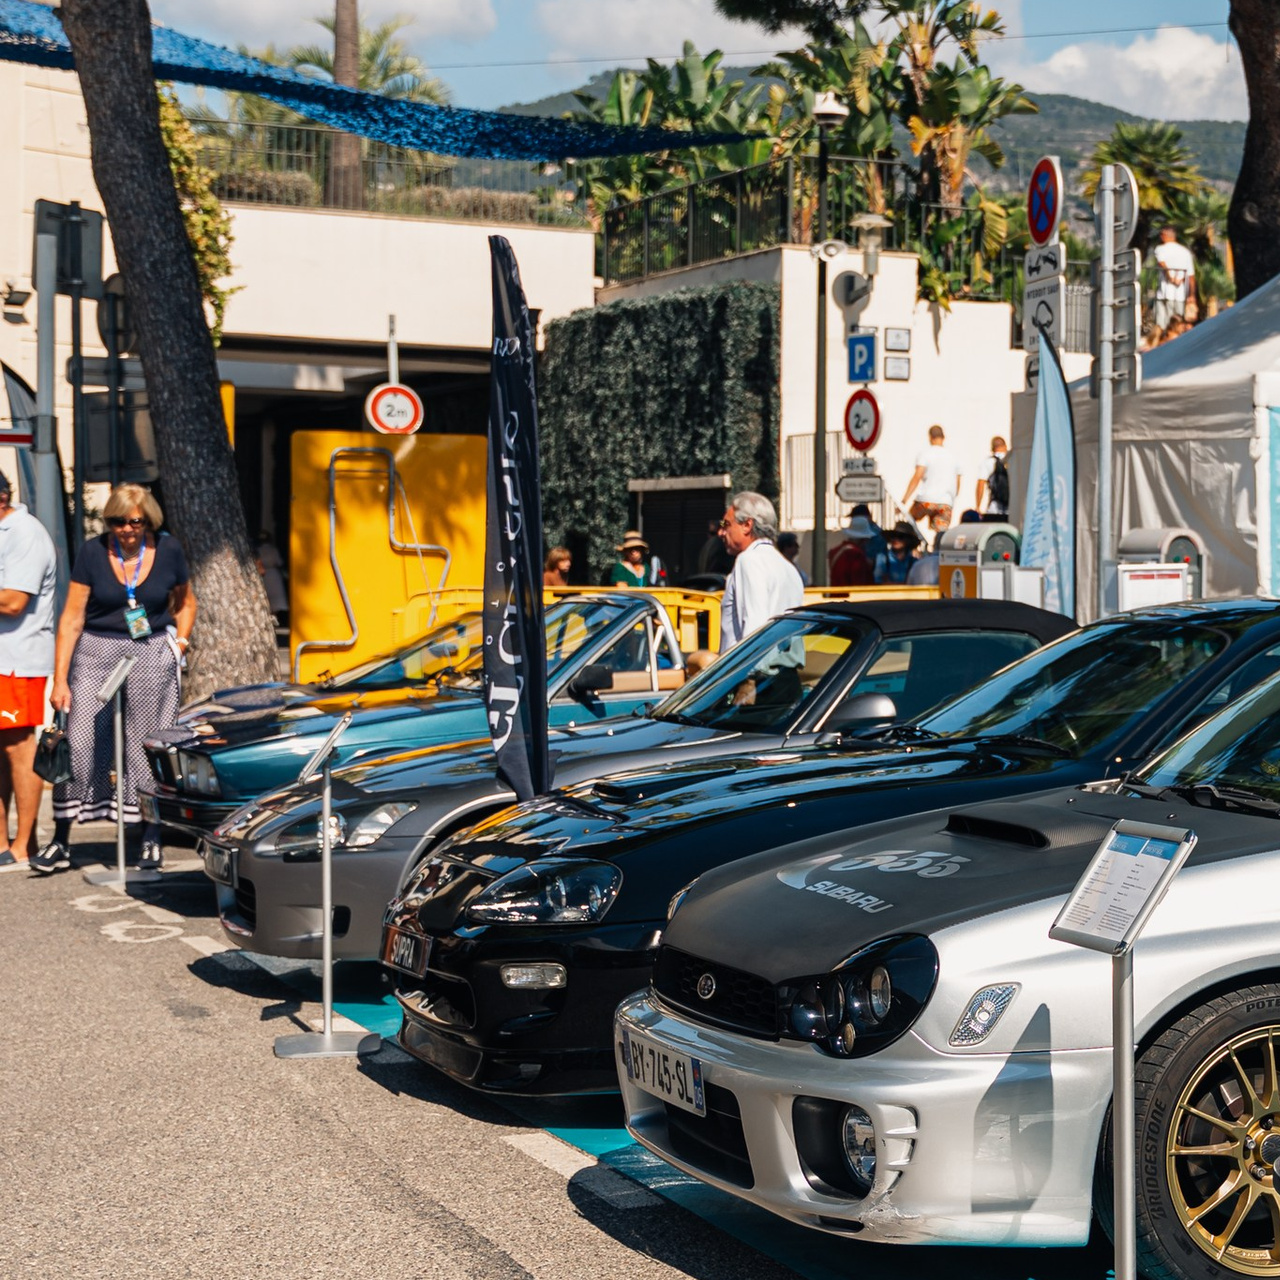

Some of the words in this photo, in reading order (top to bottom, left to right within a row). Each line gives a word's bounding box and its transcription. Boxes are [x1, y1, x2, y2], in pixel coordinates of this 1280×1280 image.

[854, 343, 868, 374] P
[805, 880, 894, 914] SUBARU
[390, 933, 416, 969] SUPRA
[1143, 1097, 1167, 1221] BRIDGESTONE
